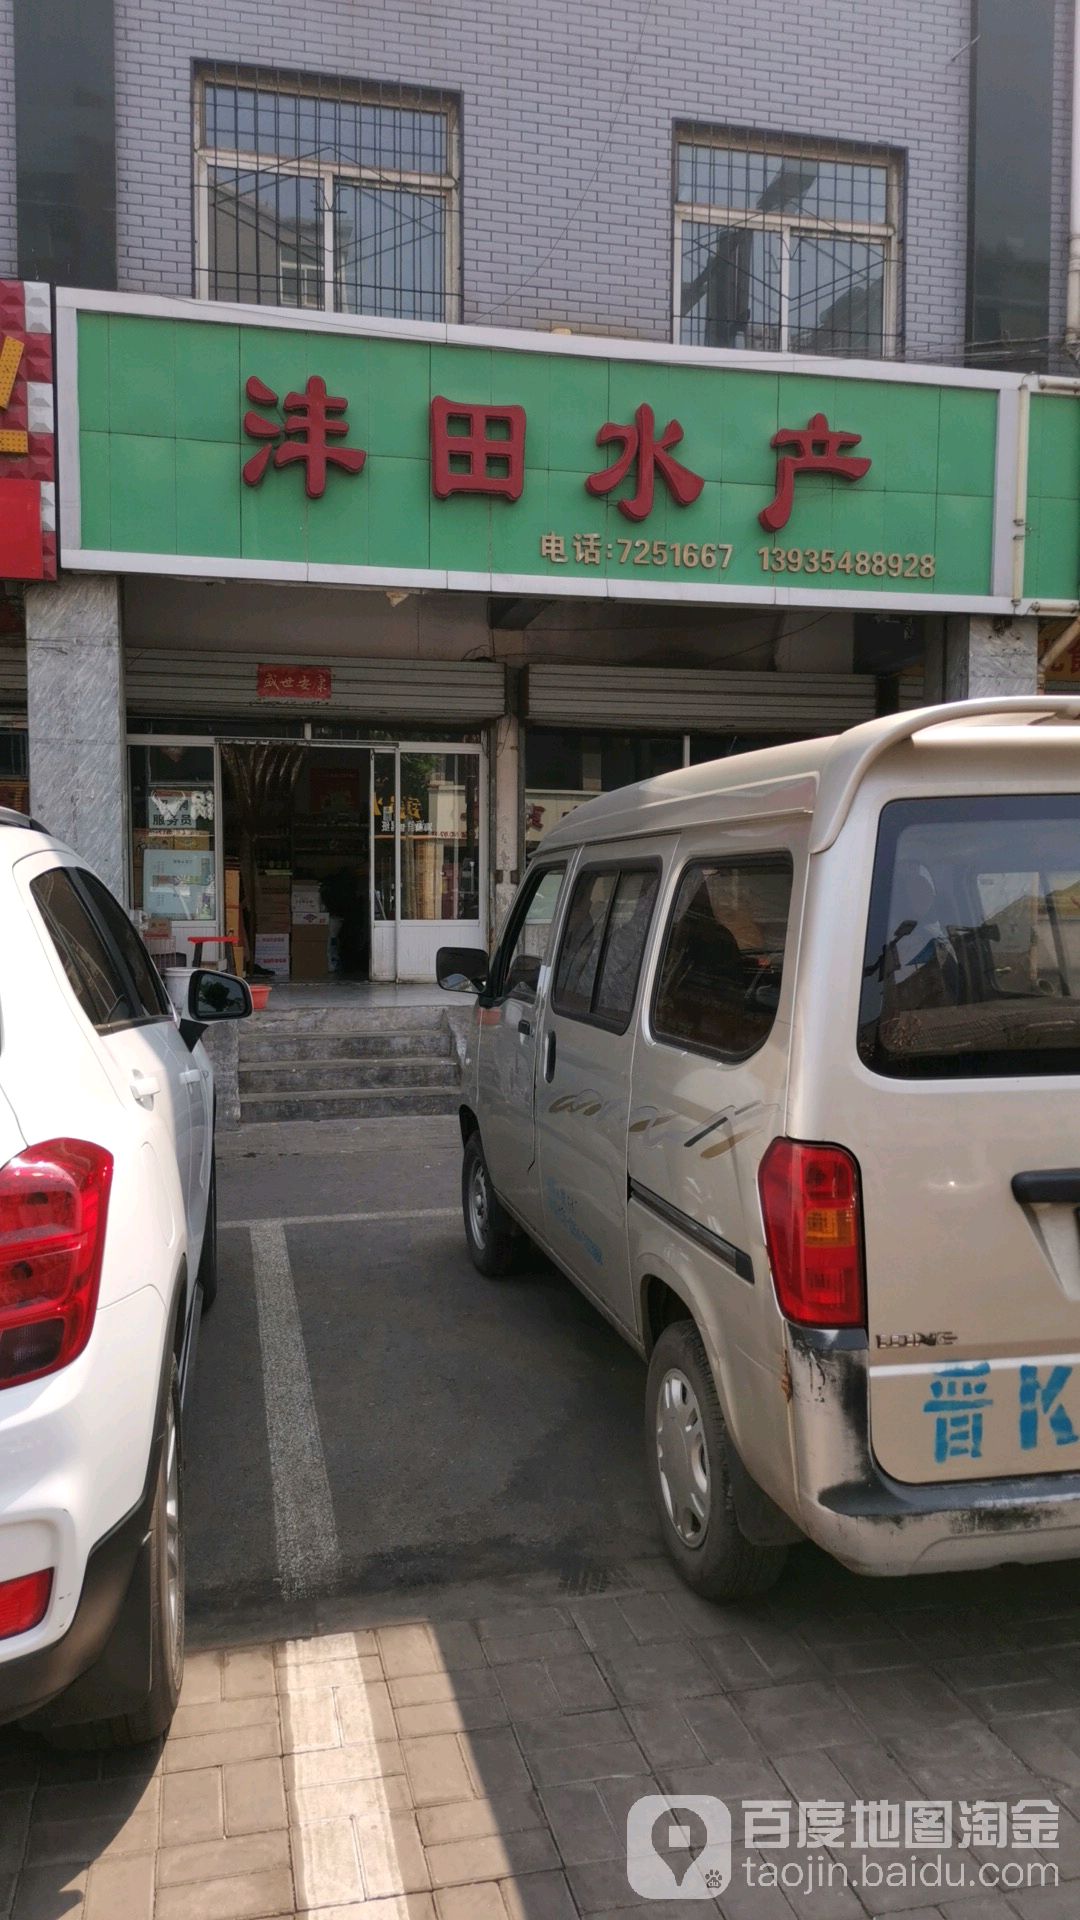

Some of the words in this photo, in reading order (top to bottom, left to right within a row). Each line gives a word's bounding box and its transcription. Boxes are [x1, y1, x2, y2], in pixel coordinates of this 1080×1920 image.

[242, 375, 872, 531] 沣田水产
[541, 531, 734, 569] 电话:7251667
[758, 546, 936, 578] 13935488928
